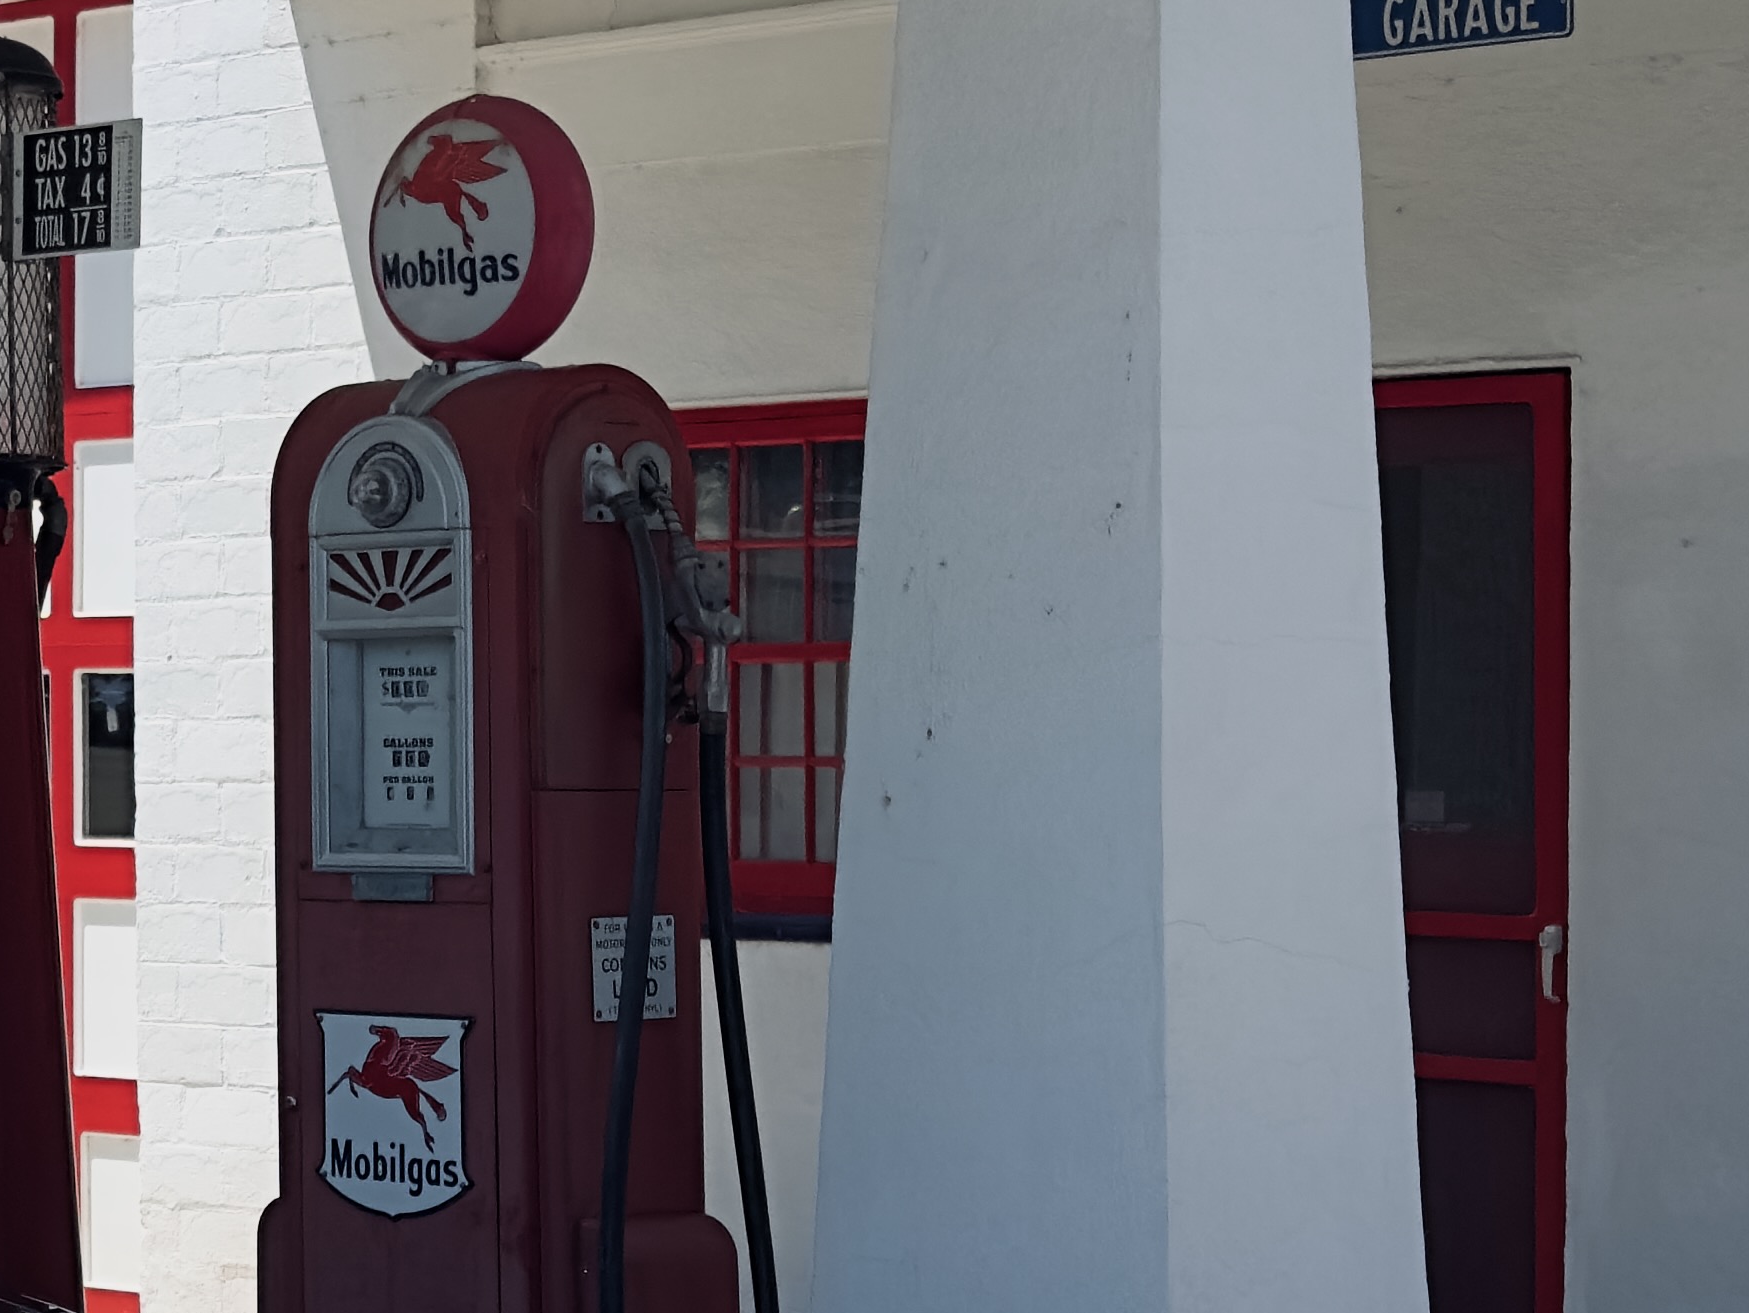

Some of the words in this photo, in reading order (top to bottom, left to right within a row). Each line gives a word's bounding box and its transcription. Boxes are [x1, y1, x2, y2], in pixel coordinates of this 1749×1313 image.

[35, 136, 67, 172] GAS
[73, 133, 93, 168] 13
[34, 175, 66, 210] TAX
[34, 214, 66, 249] TOTAL
[72, 211, 91, 245] 17
[381, 247, 520, 296] Mobilgas
[383, 737, 434, 749] GALLONS
[601, 955, 667, 973] CONS
[612, 978, 658, 999] LD
[330, 1138, 459, 1197] Mobilgas
